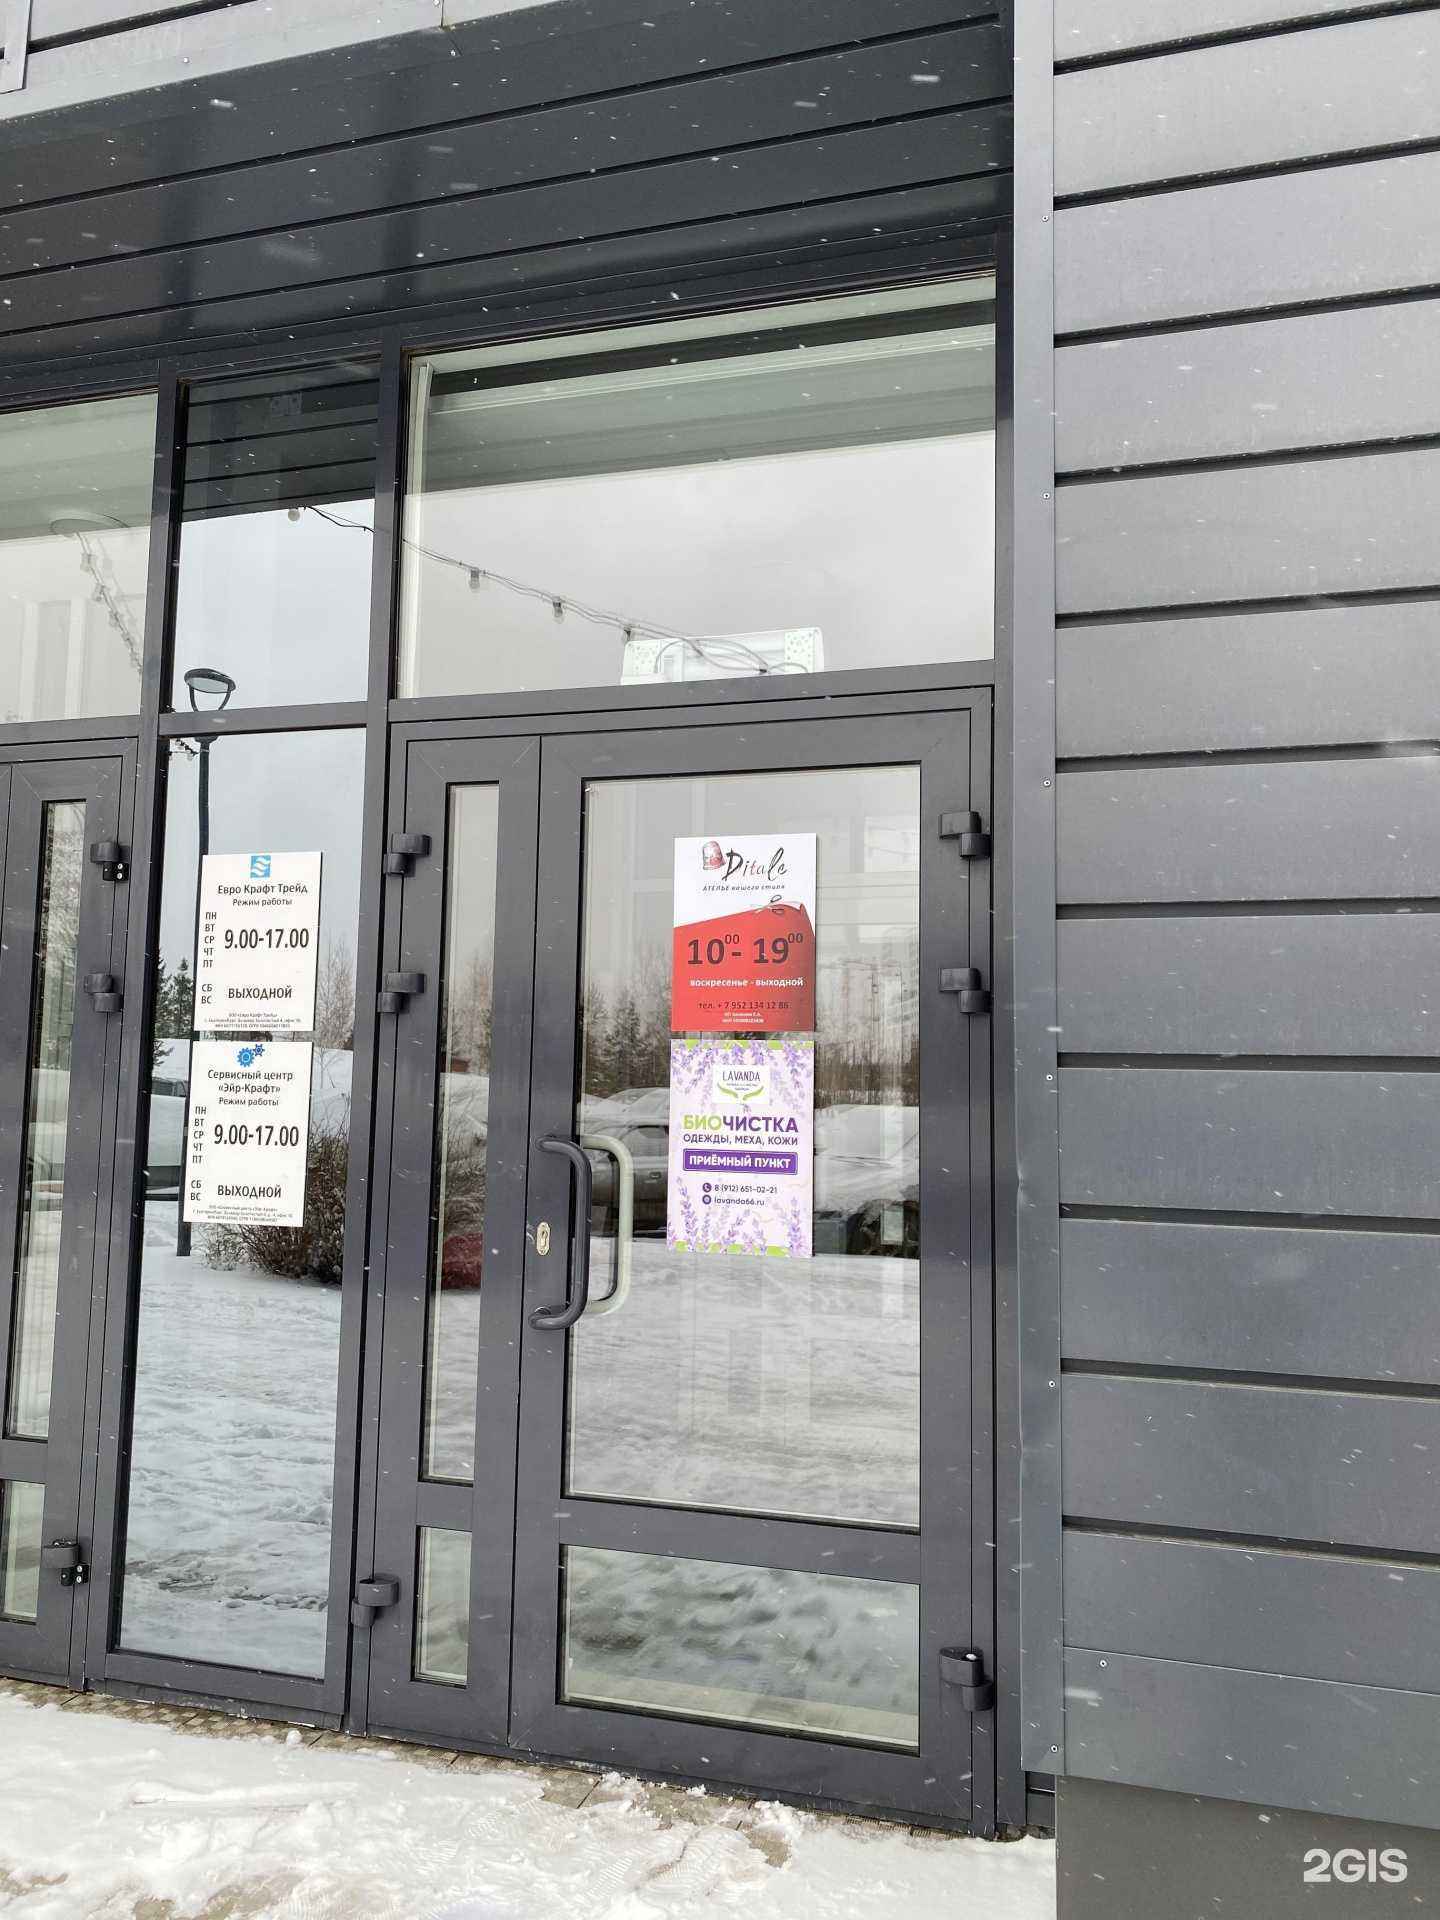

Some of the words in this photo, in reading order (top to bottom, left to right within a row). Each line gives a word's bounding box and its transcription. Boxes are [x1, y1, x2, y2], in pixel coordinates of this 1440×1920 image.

[217, 885, 241, 896] Евро
[244, 884, 275, 896] Крафт
[278, 882, 308, 894] Трейд
[232, 898, 260, 906] Режим
[261, 898, 293, 907] работы
[205, 911, 217, 920] ПН
[204, 923, 216, 932] ВТ
[204, 935, 215, 944] СР
[224, 928, 310, 949] 9.00-17.00
[203, 947, 214, 956] ЧТ
[202, 959, 213, 968] ПТ
[690, 979, 748, 988] воскресенье
[755, 977, 804, 988] выходной
[201, 984, 213, 992] СБ
[228, 985, 293, 1001] ВЫХОДНОЙ
[201, 996, 212, 1004] ВС
[207, 1069, 261, 1080] Сервисный
[264, 1071, 293, 1081] центр
[722, 1070, 761, 1082] LAVANDA
[218, 1083, 281, 1094] «Эйр-Крафт»
[218, 1097, 246, 1105] Режим
[248, 1097, 279, 1107] работы
[195, 1106, 207, 1115] ПН
[194, 1118, 204, 1127] ВТ
[683, 1114, 799, 1133] БИОЧИСТКА
[193, 1131, 204, 1139] СР
[214, 1124, 299, 1146] 9.00-17.00
[683, 1133, 732, 1145] ОДЕЖДЫ,
[734, 1135, 765, 1146] МЕХА,
[767, 1136, 798, 1146] КОЖИ
[193, 1143, 203, 1151] ЧТ
[192, 1155, 203, 1164] ПТ
[689, 1154, 752, 1167] ПРИЁМНЫЙ
[754, 1157, 791, 1169] ПУНКТ
[191, 1180, 202, 1188] СБ
[217, 1184, 282, 1199] ВЫХОДНОЙ
[714, 1184, 719, 1192] 8
[721, 1184, 739, 1193] (912)
[740, 1185, 778, 1194] 651-02-21
[190, 1192, 201, 1201] ВС
[714, 1196, 765, 1206] lavanda66.ru
